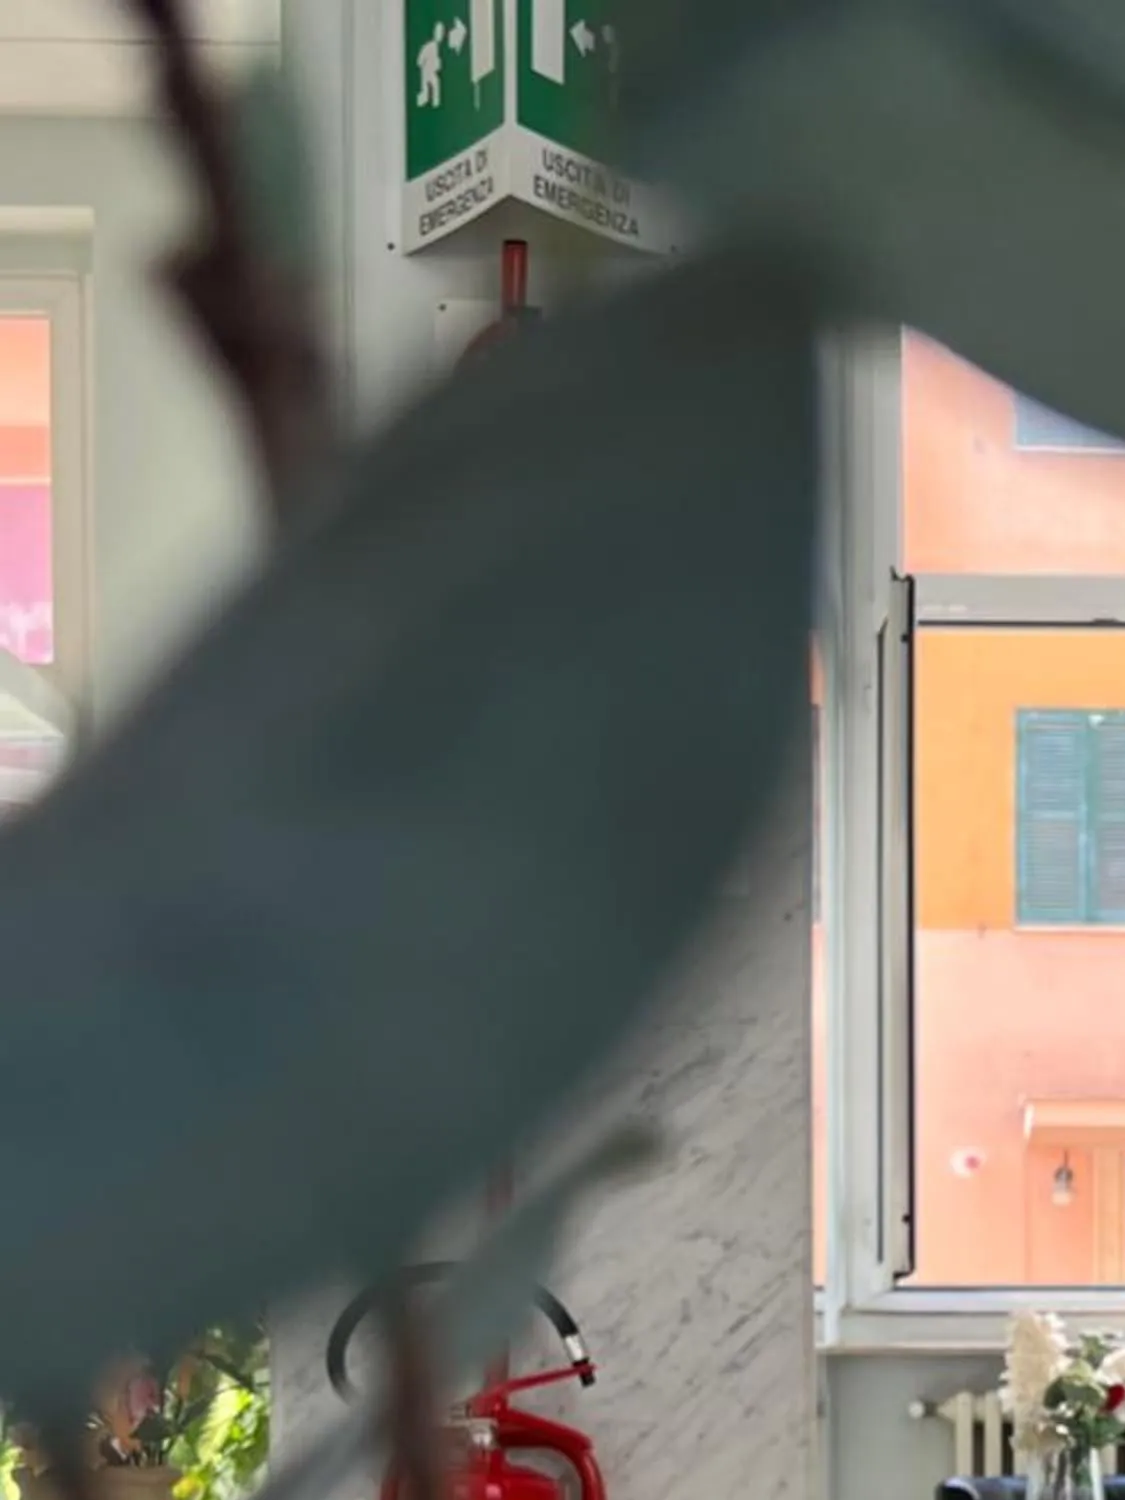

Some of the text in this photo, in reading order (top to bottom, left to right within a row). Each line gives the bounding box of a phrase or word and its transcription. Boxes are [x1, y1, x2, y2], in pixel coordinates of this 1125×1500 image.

[425, 149, 488, 202] USCITA DI
[541, 148, 632, 205] USCITA DI
[419, 176, 495, 237] EMERGENZA
[532, 174, 640, 238] EMERGENZA
